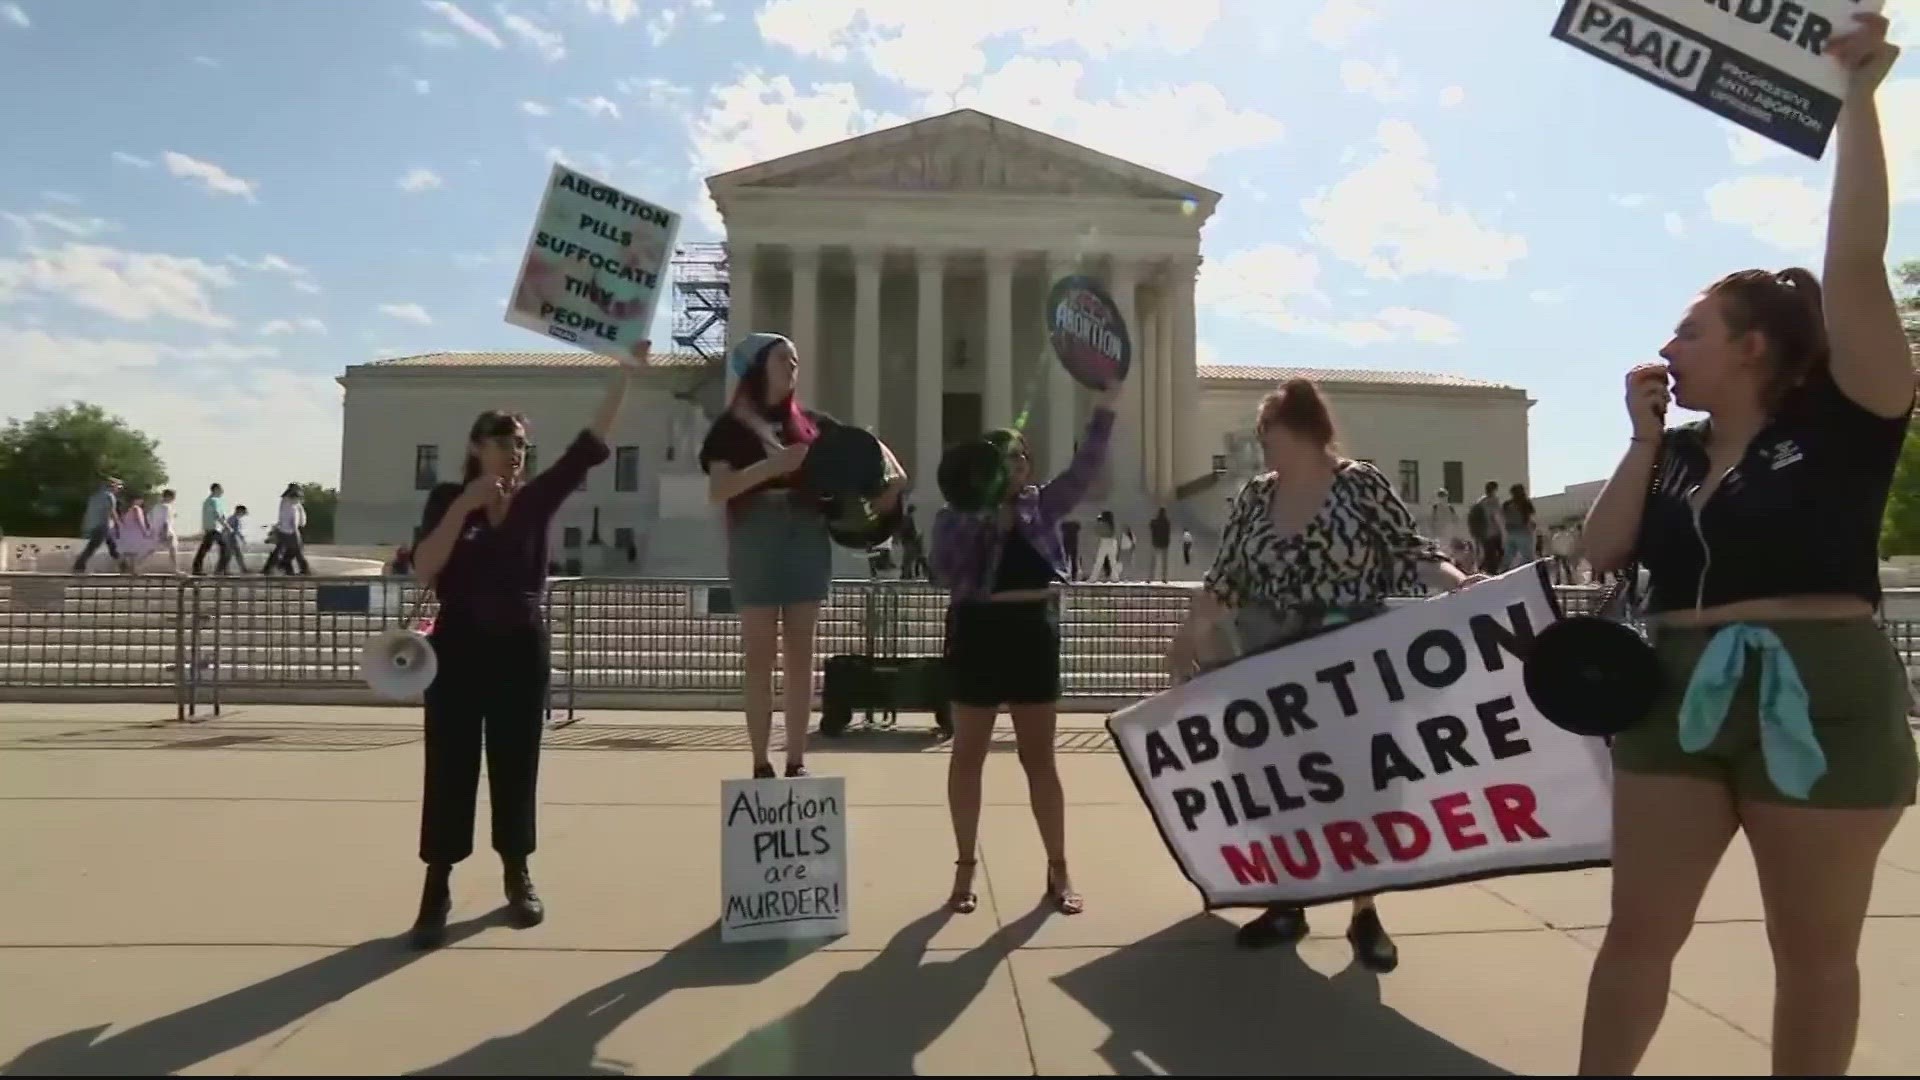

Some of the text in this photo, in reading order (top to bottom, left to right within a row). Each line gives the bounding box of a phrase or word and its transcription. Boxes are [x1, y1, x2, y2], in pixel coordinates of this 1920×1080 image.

[1578, 3, 1701, 78] PAAU
[560, 173, 670, 228] ABORTION
[579, 212, 634, 247] PILLS
[536, 231, 658, 289] SUFFOCATE
[540, 301, 618, 341] PEOPLE
[1055, 303, 1122, 362] ABORTION
[1145, 601, 1538, 779] ABORTION
[1172, 695, 1532, 832] PILLS ARE
[727, 786, 839, 827] Abortion
[753, 825, 831, 864] PILLS
[1219, 782, 1551, 887] MURDER
[764, 864, 808, 884] are
[725, 882, 841, 923] MURDER!
